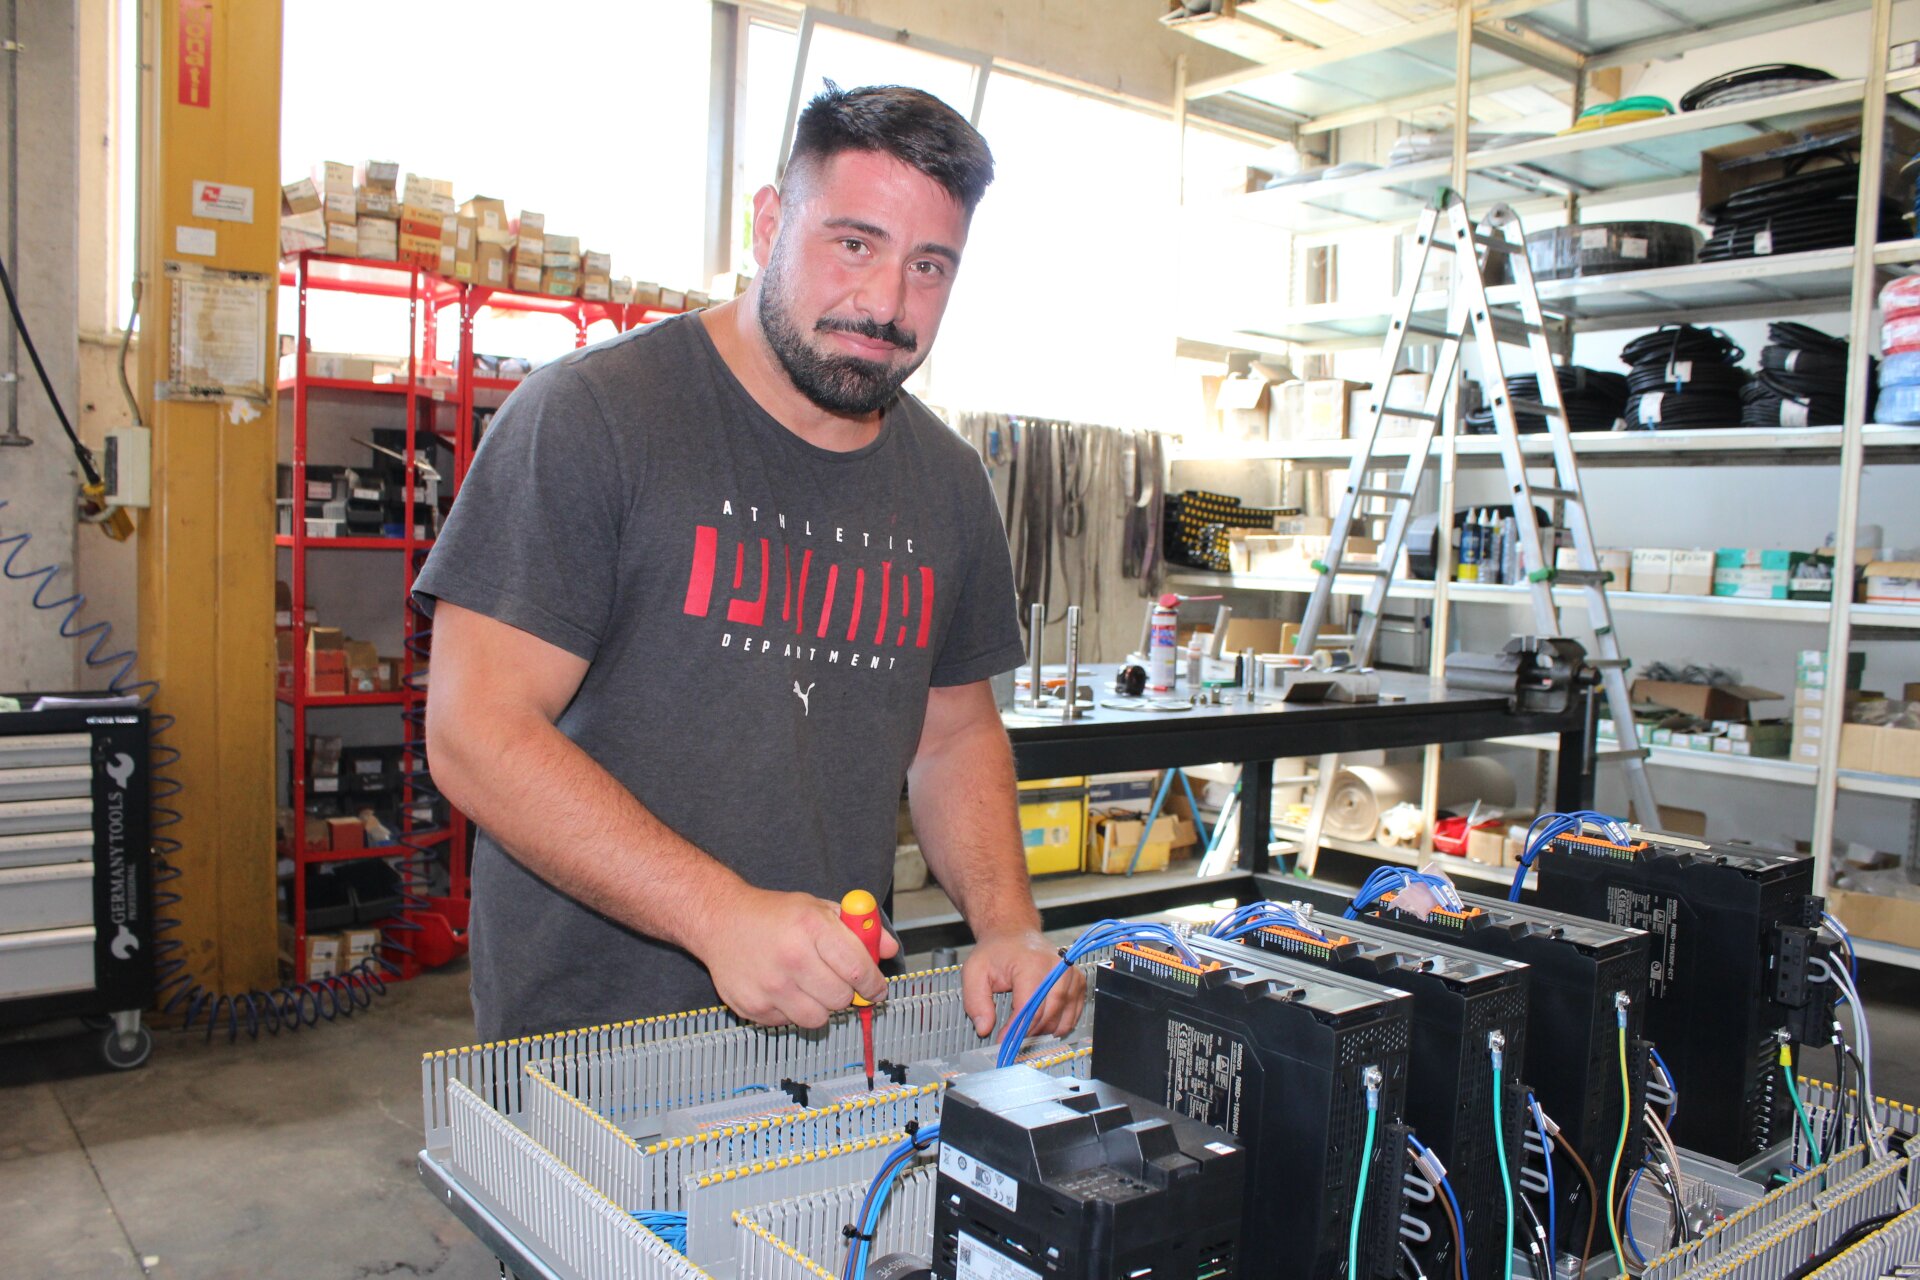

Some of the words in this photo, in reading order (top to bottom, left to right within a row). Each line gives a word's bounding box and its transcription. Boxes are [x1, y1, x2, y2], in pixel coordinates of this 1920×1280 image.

[723, 500, 914, 554] ATHLETIC
[721, 633, 896, 670] DEPARTMENT
[108, 791, 123, 845] TOOLS
[109, 846, 126, 924] GERMANY
